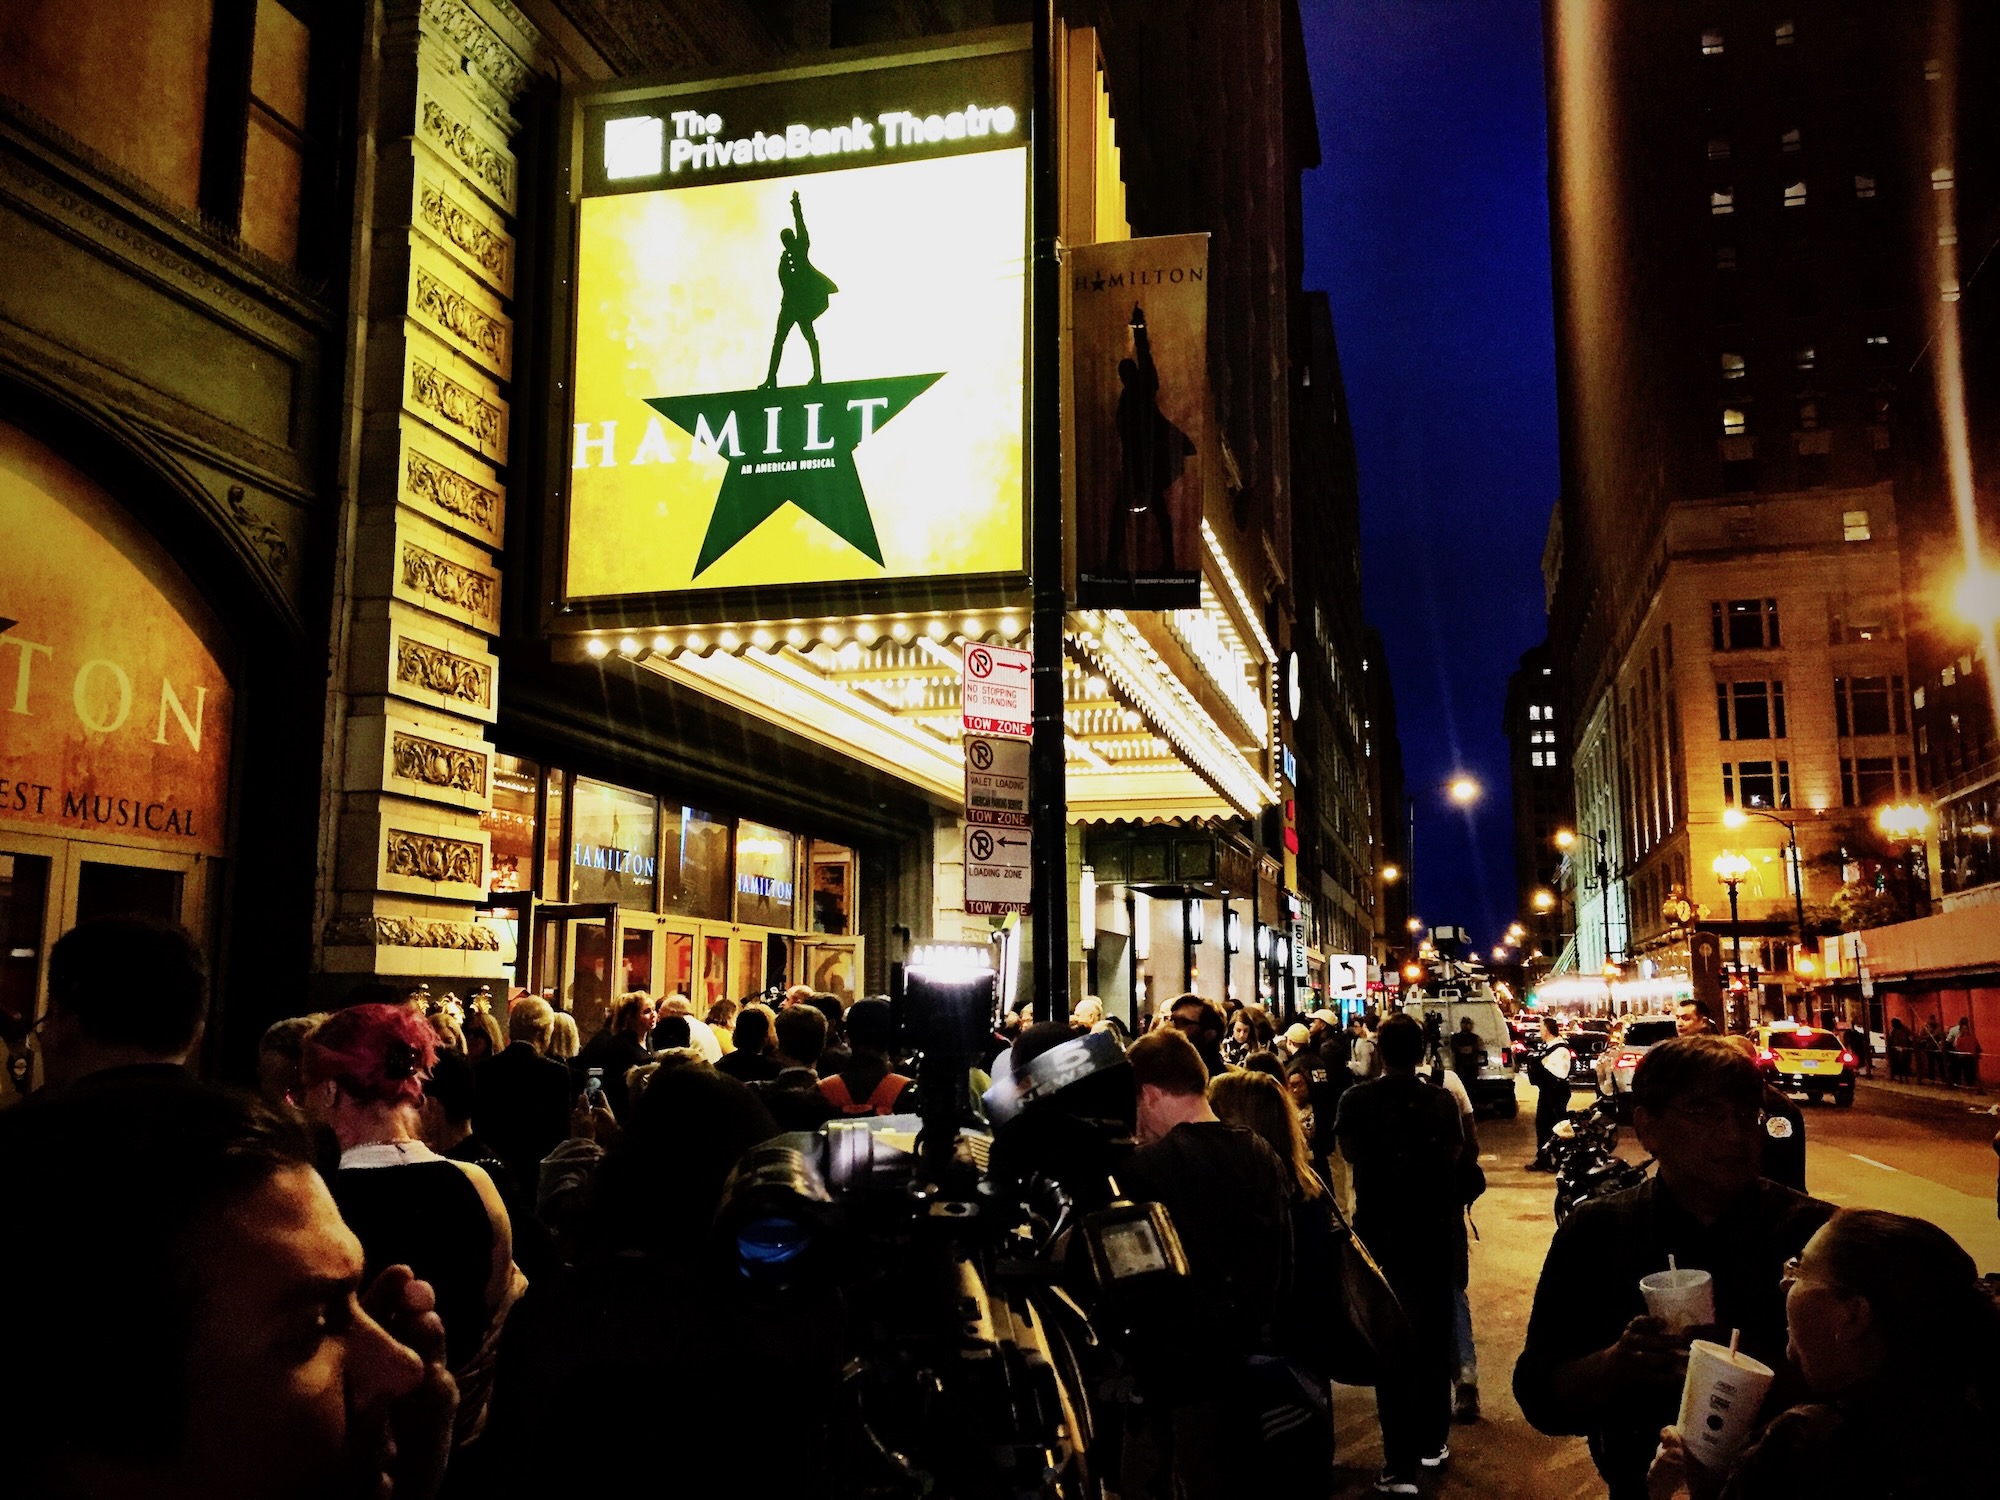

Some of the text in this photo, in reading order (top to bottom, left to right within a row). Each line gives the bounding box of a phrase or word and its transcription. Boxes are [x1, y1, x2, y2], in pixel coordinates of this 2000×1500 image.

[671, 109, 722, 138] The
[669, 103, 1015, 172] PrivateBank Theatre
[741, 457, 836, 475] AN AMERICAN MUSICAL
[967, 684, 1017, 699] NO STOPPING
[967, 693, 1017, 709] NO STANDING
[967, 716, 1028, 735] TOW ZONE
[971, 776, 1025, 791] VALET LOADING
[62, 789, 197, 837] MUSICAL
[970, 810, 1027, 825] TOW ZONE
[968, 867, 1023, 879] LOADING ZONE
[969, 901, 1028, 915] TOW ZONE
[1295, 924, 1305, 969] verizon
